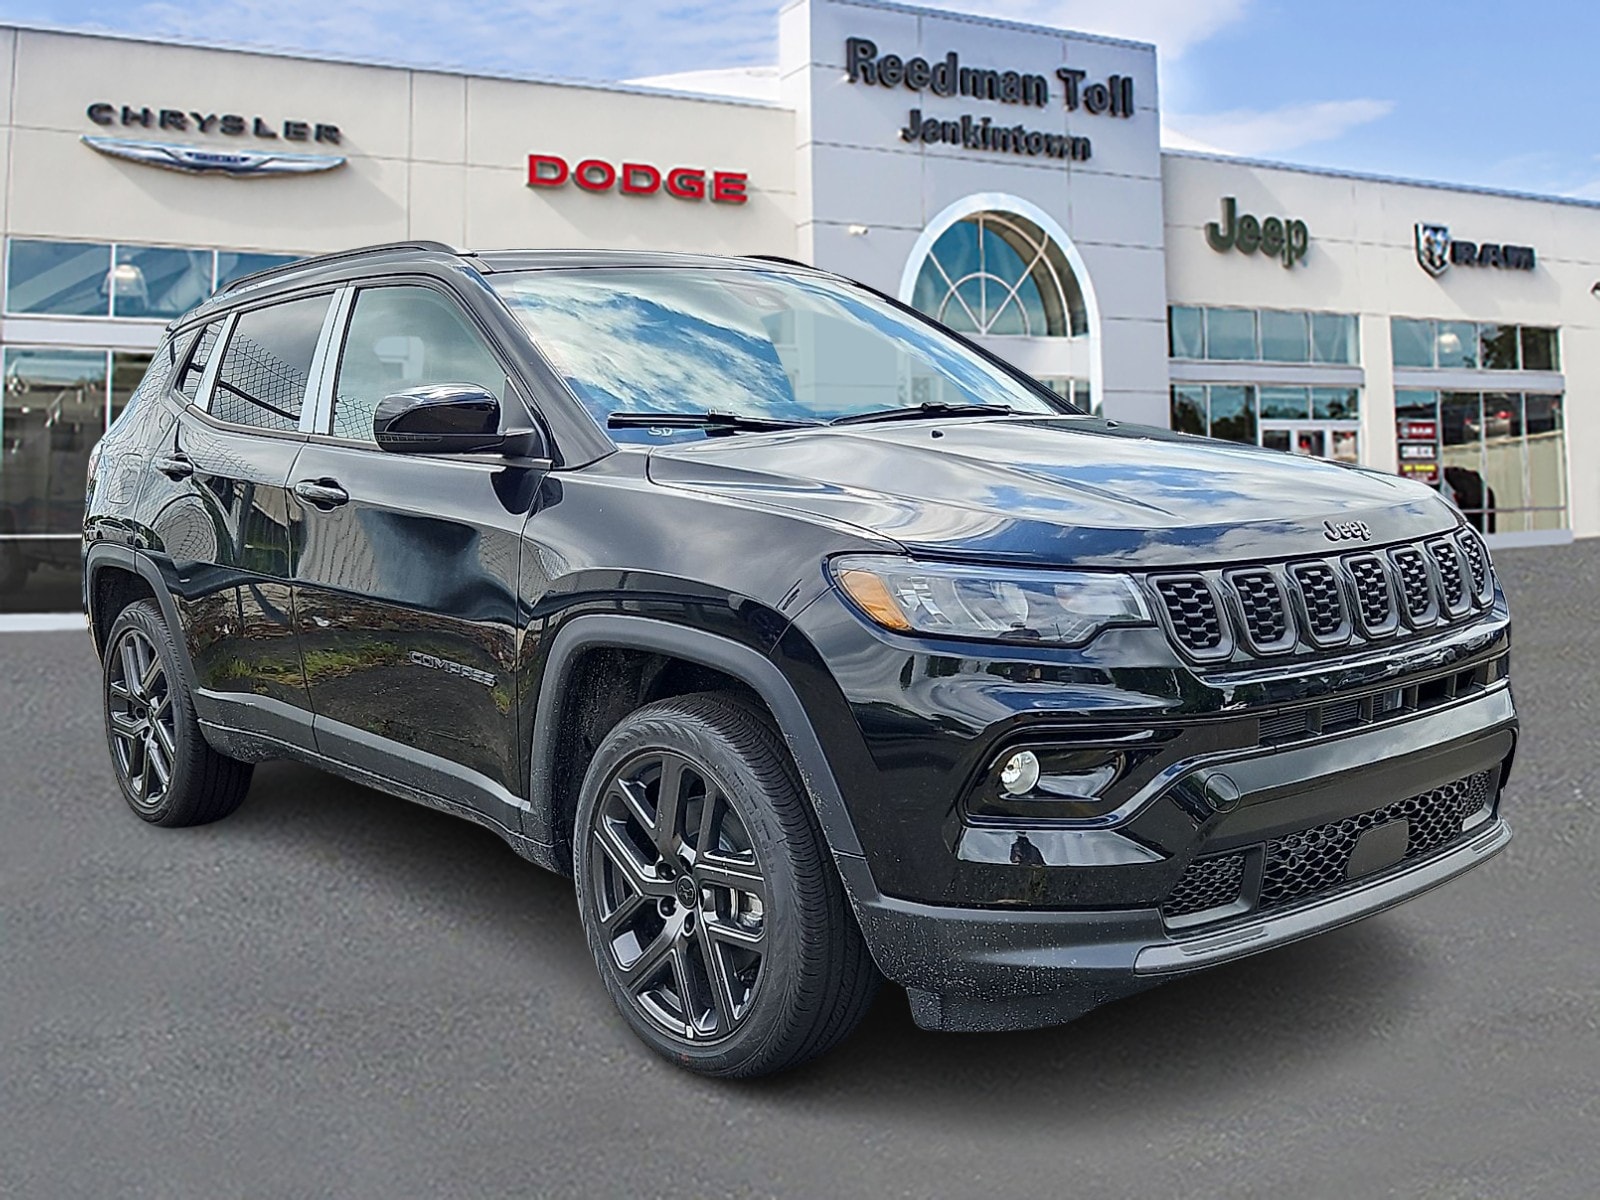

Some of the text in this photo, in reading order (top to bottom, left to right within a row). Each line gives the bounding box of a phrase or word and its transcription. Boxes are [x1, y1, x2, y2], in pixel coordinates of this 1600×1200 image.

[845, 37, 1134, 118] Reedman Toll
[86, 102, 343, 145] CHRYSLER
[900, 109, 1092, 161] Jenkintown
[526, 154, 749, 204] DODGE
[1205, 197, 1308, 269] Jeep
[1449, 241, 1536, 270] RAM
[1323, 519, 1372, 543] Jeep
[409, 650, 498, 688] COMPASS
